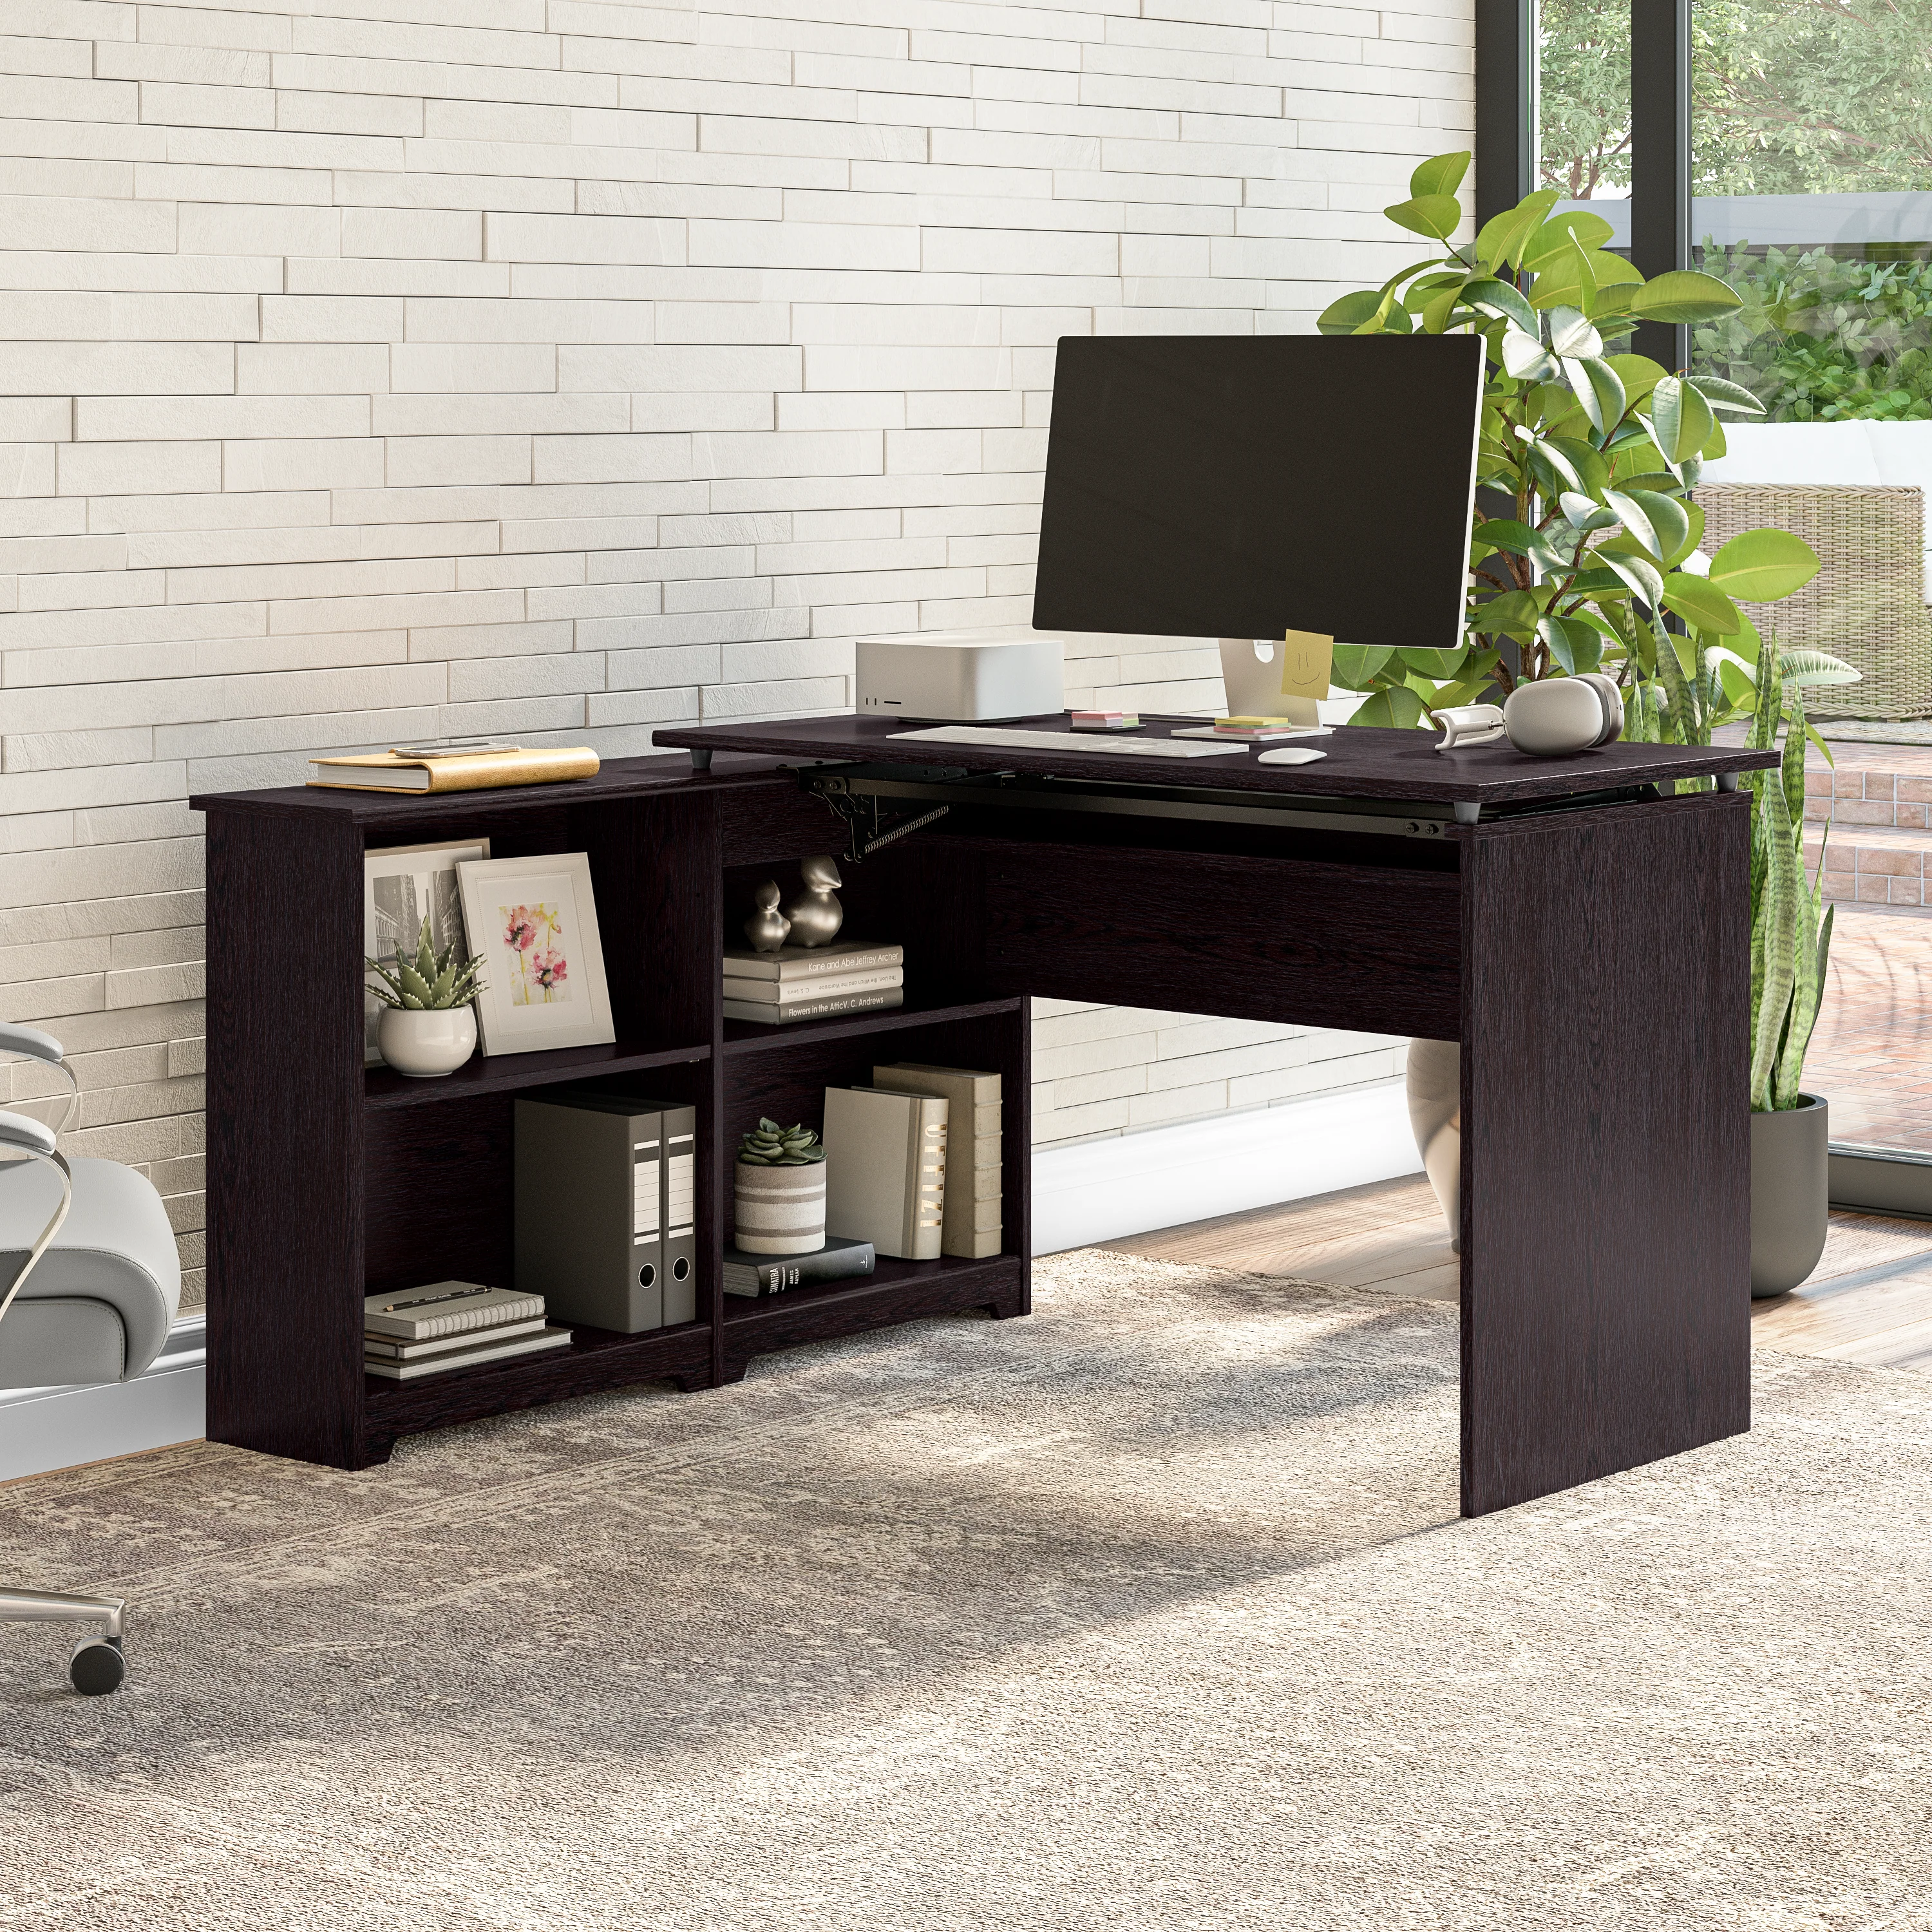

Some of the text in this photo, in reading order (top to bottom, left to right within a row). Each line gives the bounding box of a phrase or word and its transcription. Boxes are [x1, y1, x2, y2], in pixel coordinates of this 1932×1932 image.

[808, 963, 825, 972] Kane
[827, 959, 840, 970] and
[878, 952, 898, 962] Archer
[789, 1007, 811, 1017] Flowers
[811, 1005, 818, 1014] in
[819, 1004, 828, 1013] the
[858, 997, 884, 1007] Andrews
[920, 1123, 947, 1227] UFFIZI
[769, 1267, 779, 1294] SINATRA
